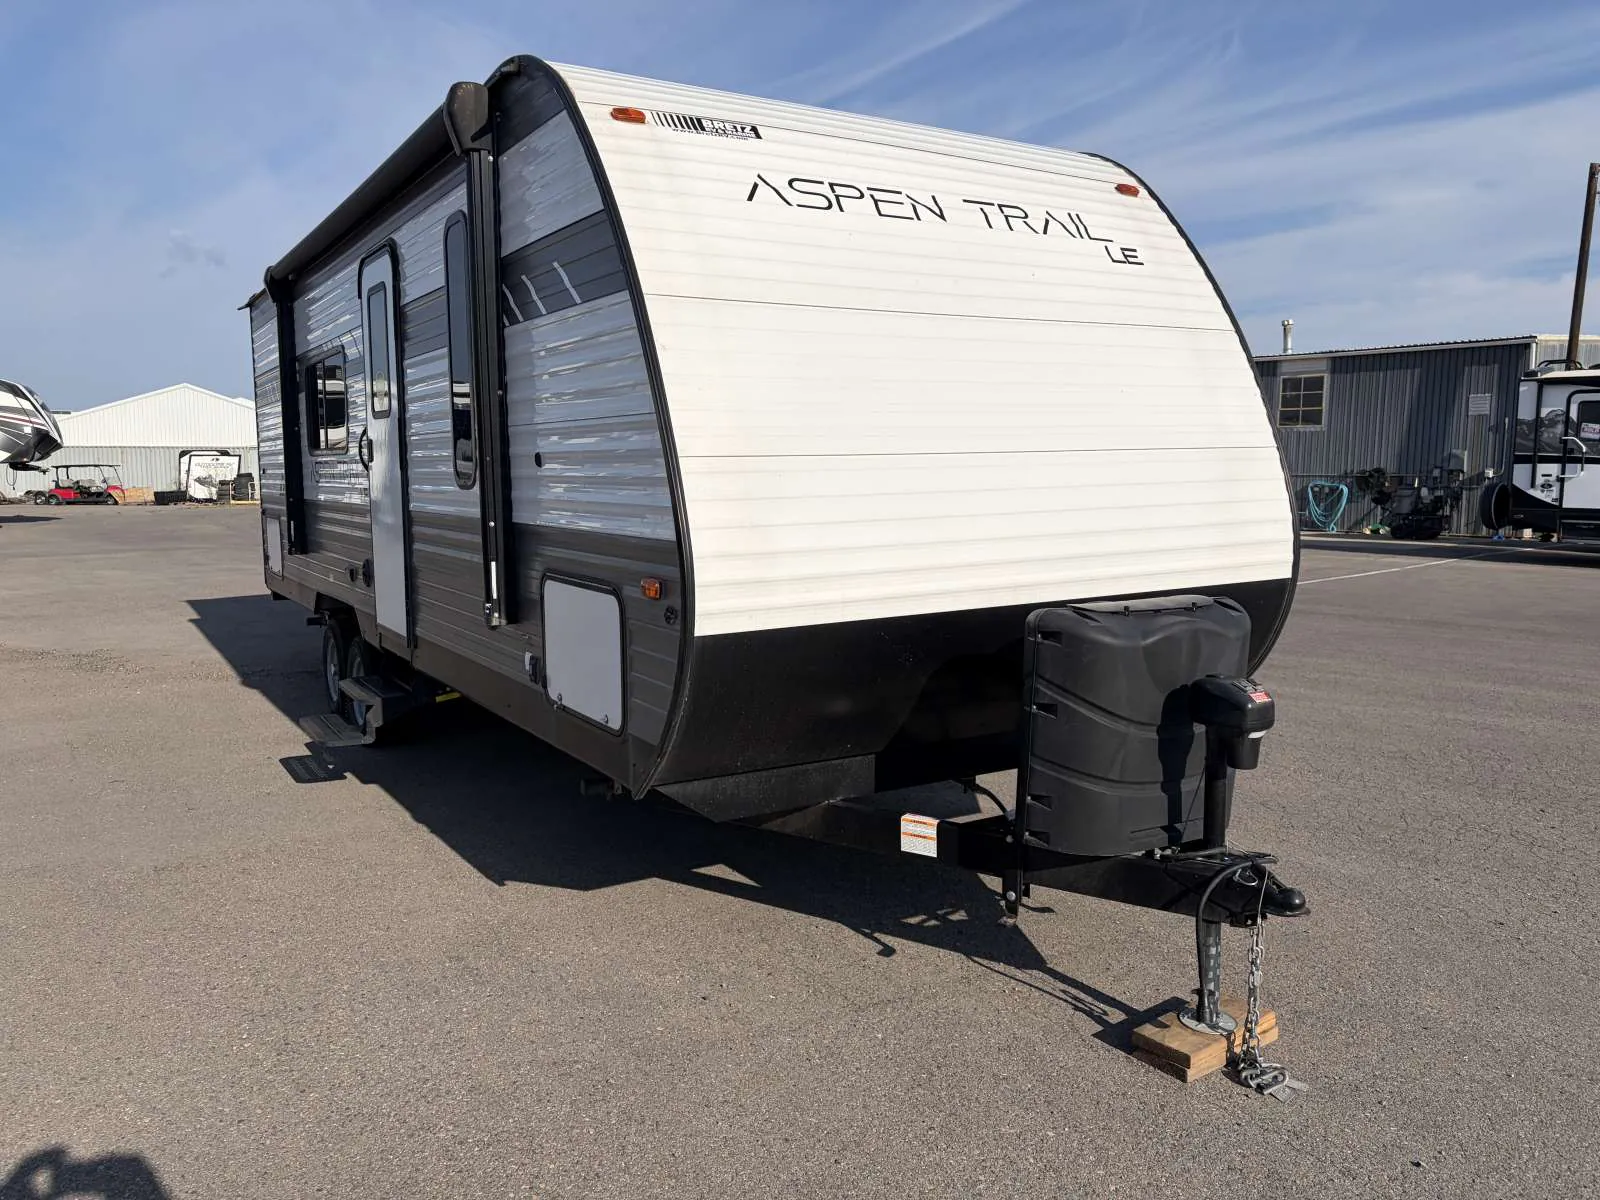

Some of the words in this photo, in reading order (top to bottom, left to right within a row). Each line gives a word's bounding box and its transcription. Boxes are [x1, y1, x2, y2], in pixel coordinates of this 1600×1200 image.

[701, 119, 755, 133] BRETZ
[746, 173, 948, 222] ASPEN
[962, 198, 1114, 243] TRAIL
[1104, 245, 1145, 266] LE
